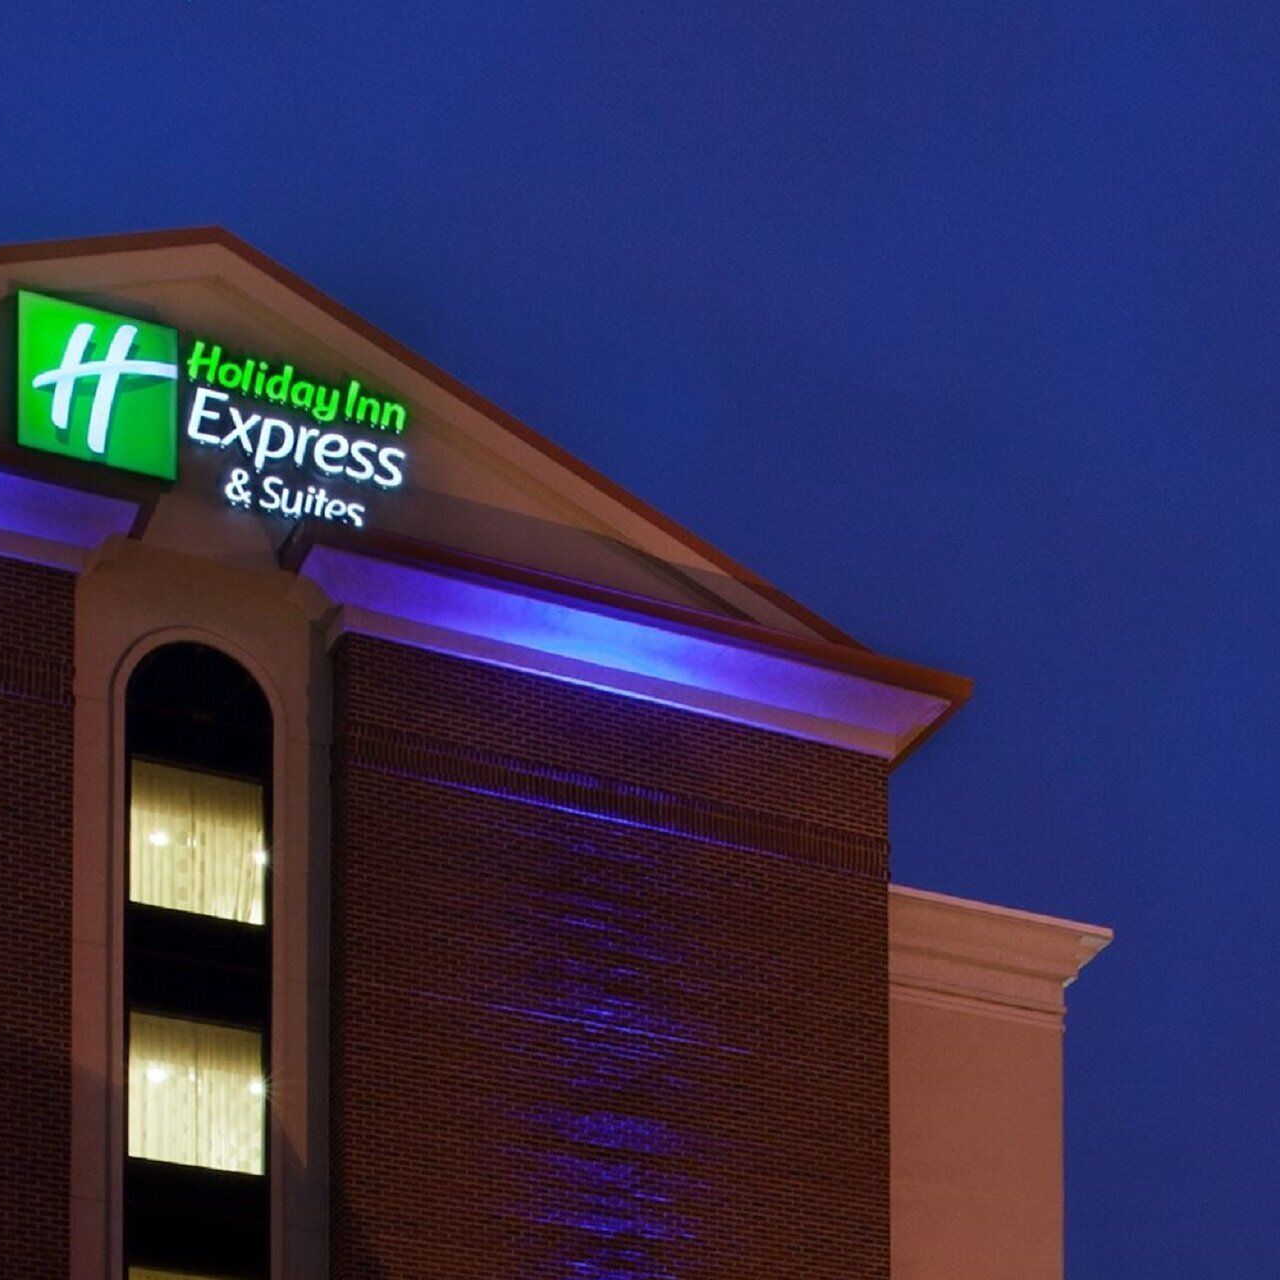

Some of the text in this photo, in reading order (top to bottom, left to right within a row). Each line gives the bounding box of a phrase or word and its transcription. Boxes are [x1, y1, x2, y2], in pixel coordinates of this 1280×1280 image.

[187, 341, 407, 432] Holiday Inn
[187, 386, 406, 488] Express
[224, 468, 366, 528] & Suites
